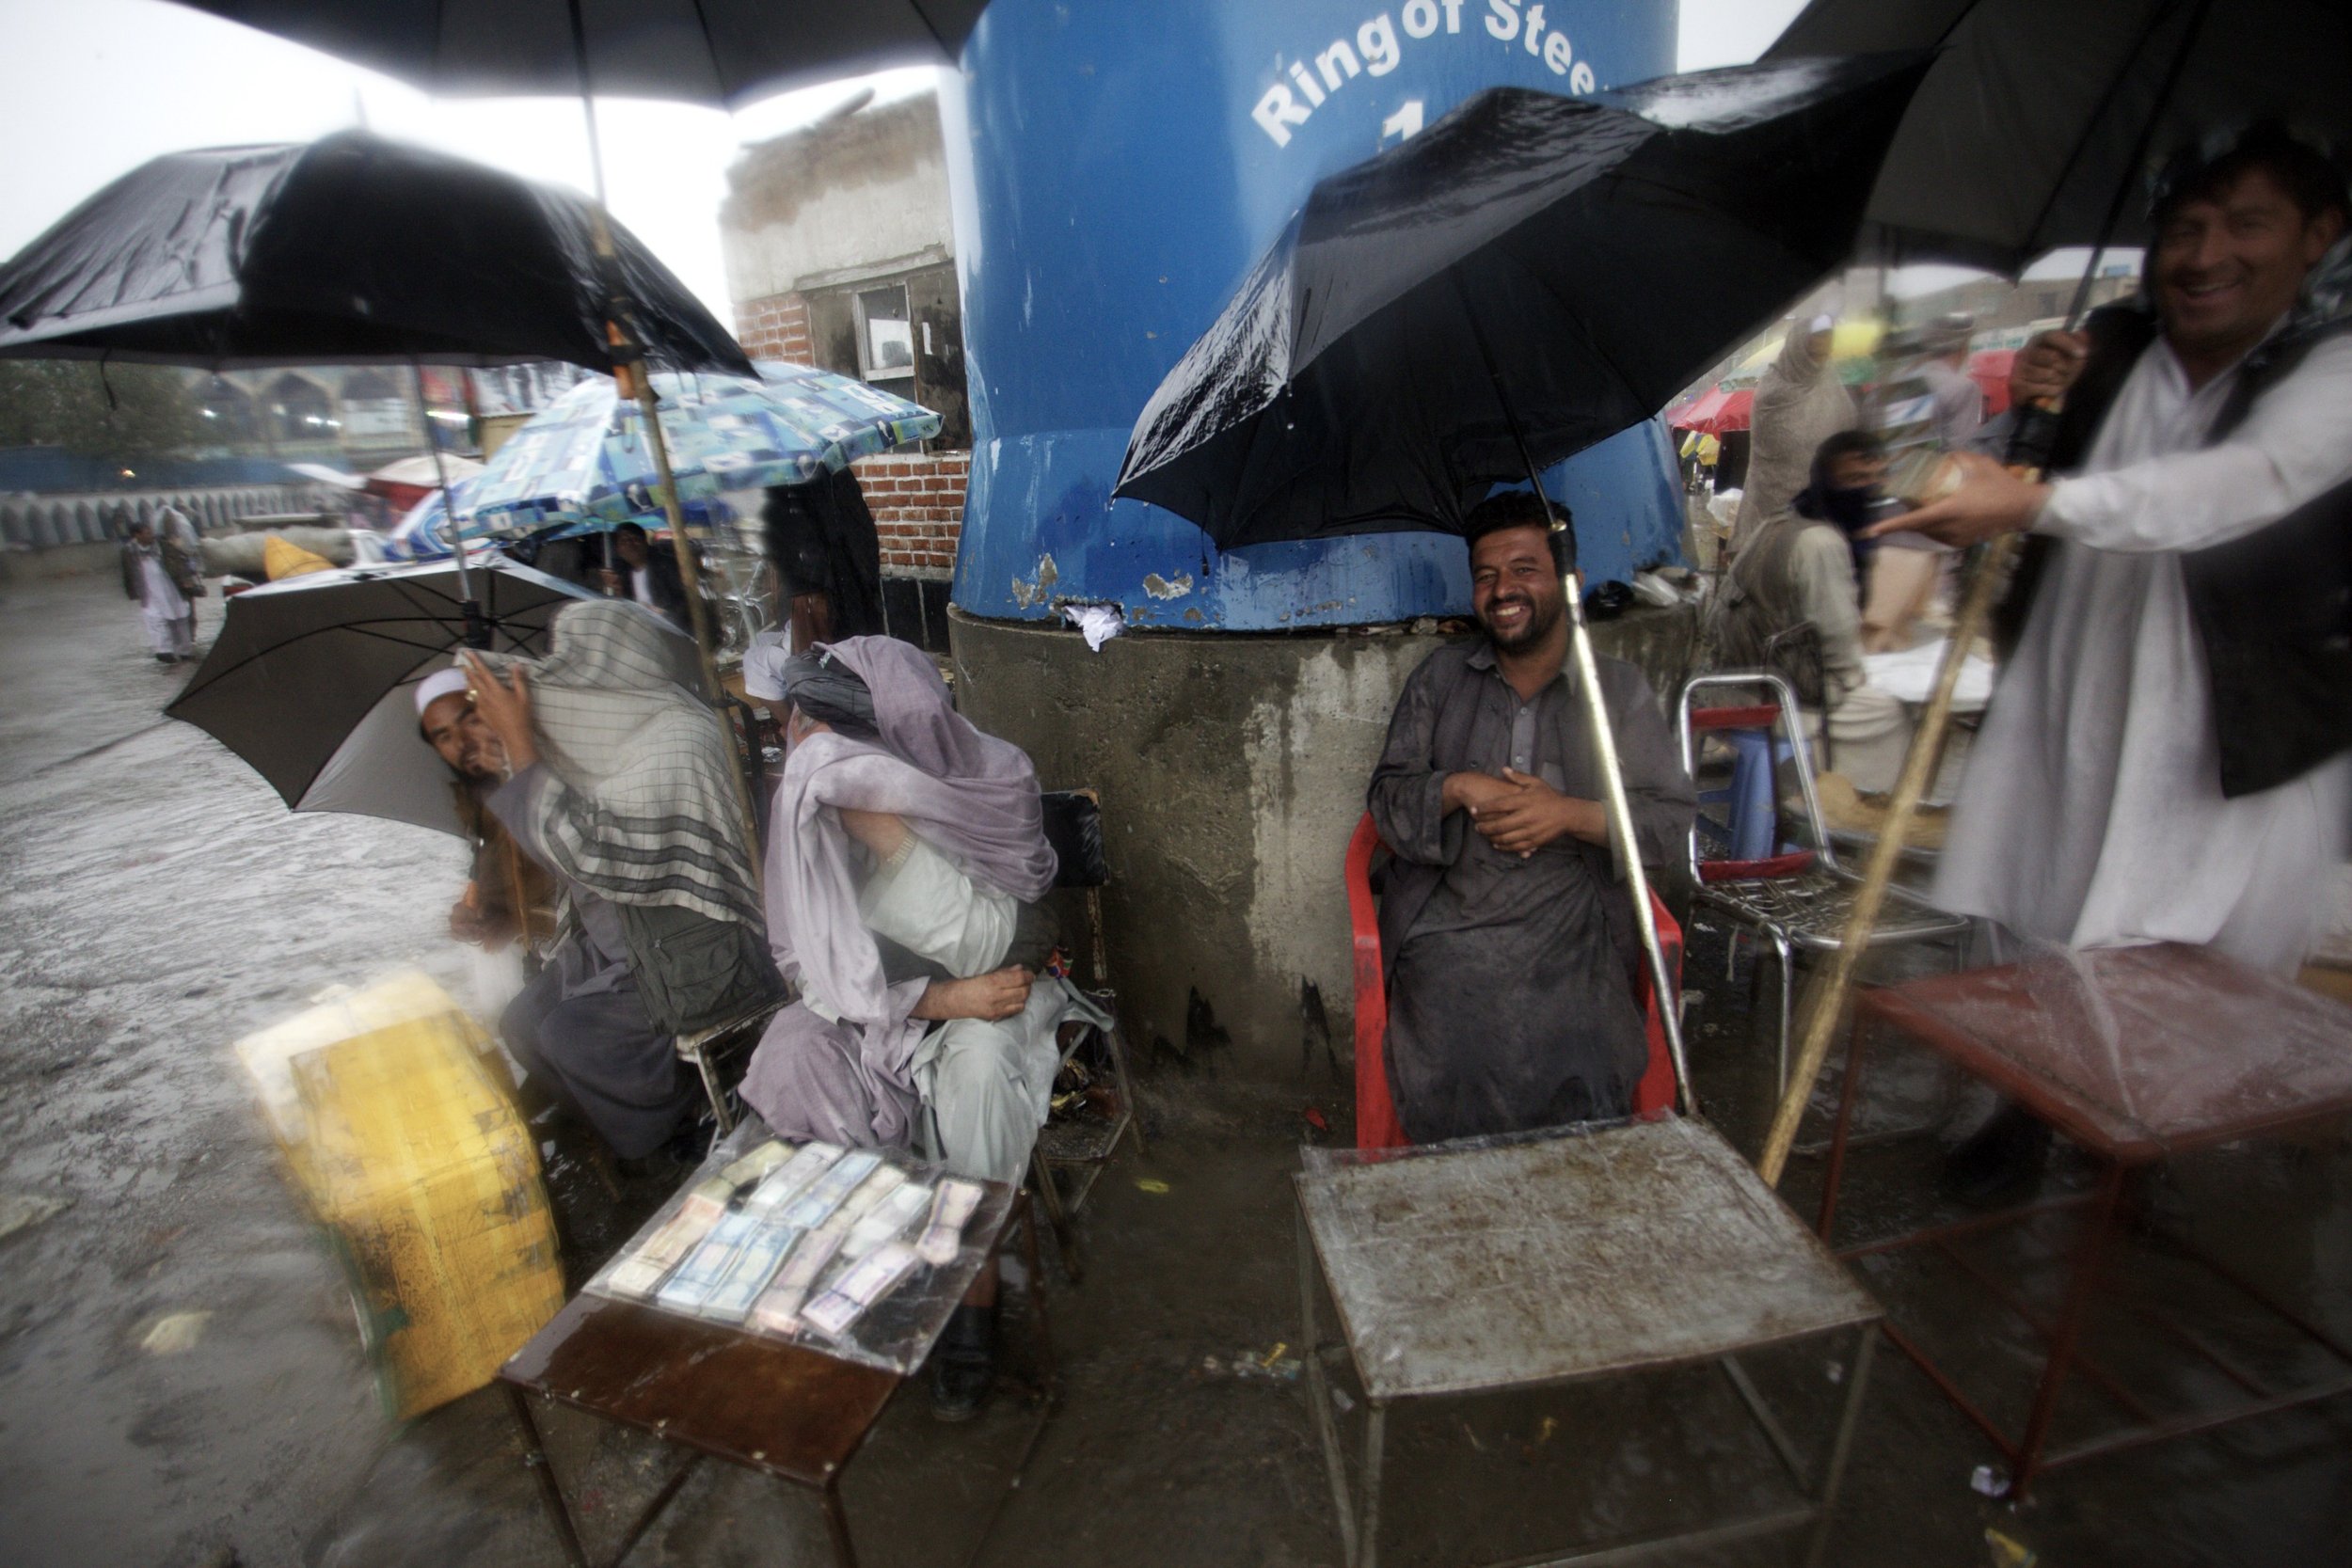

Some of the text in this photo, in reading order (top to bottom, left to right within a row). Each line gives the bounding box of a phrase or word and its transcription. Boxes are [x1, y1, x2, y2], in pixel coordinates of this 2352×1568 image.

[1250, 0, 1609, 149] Ring of Stee
